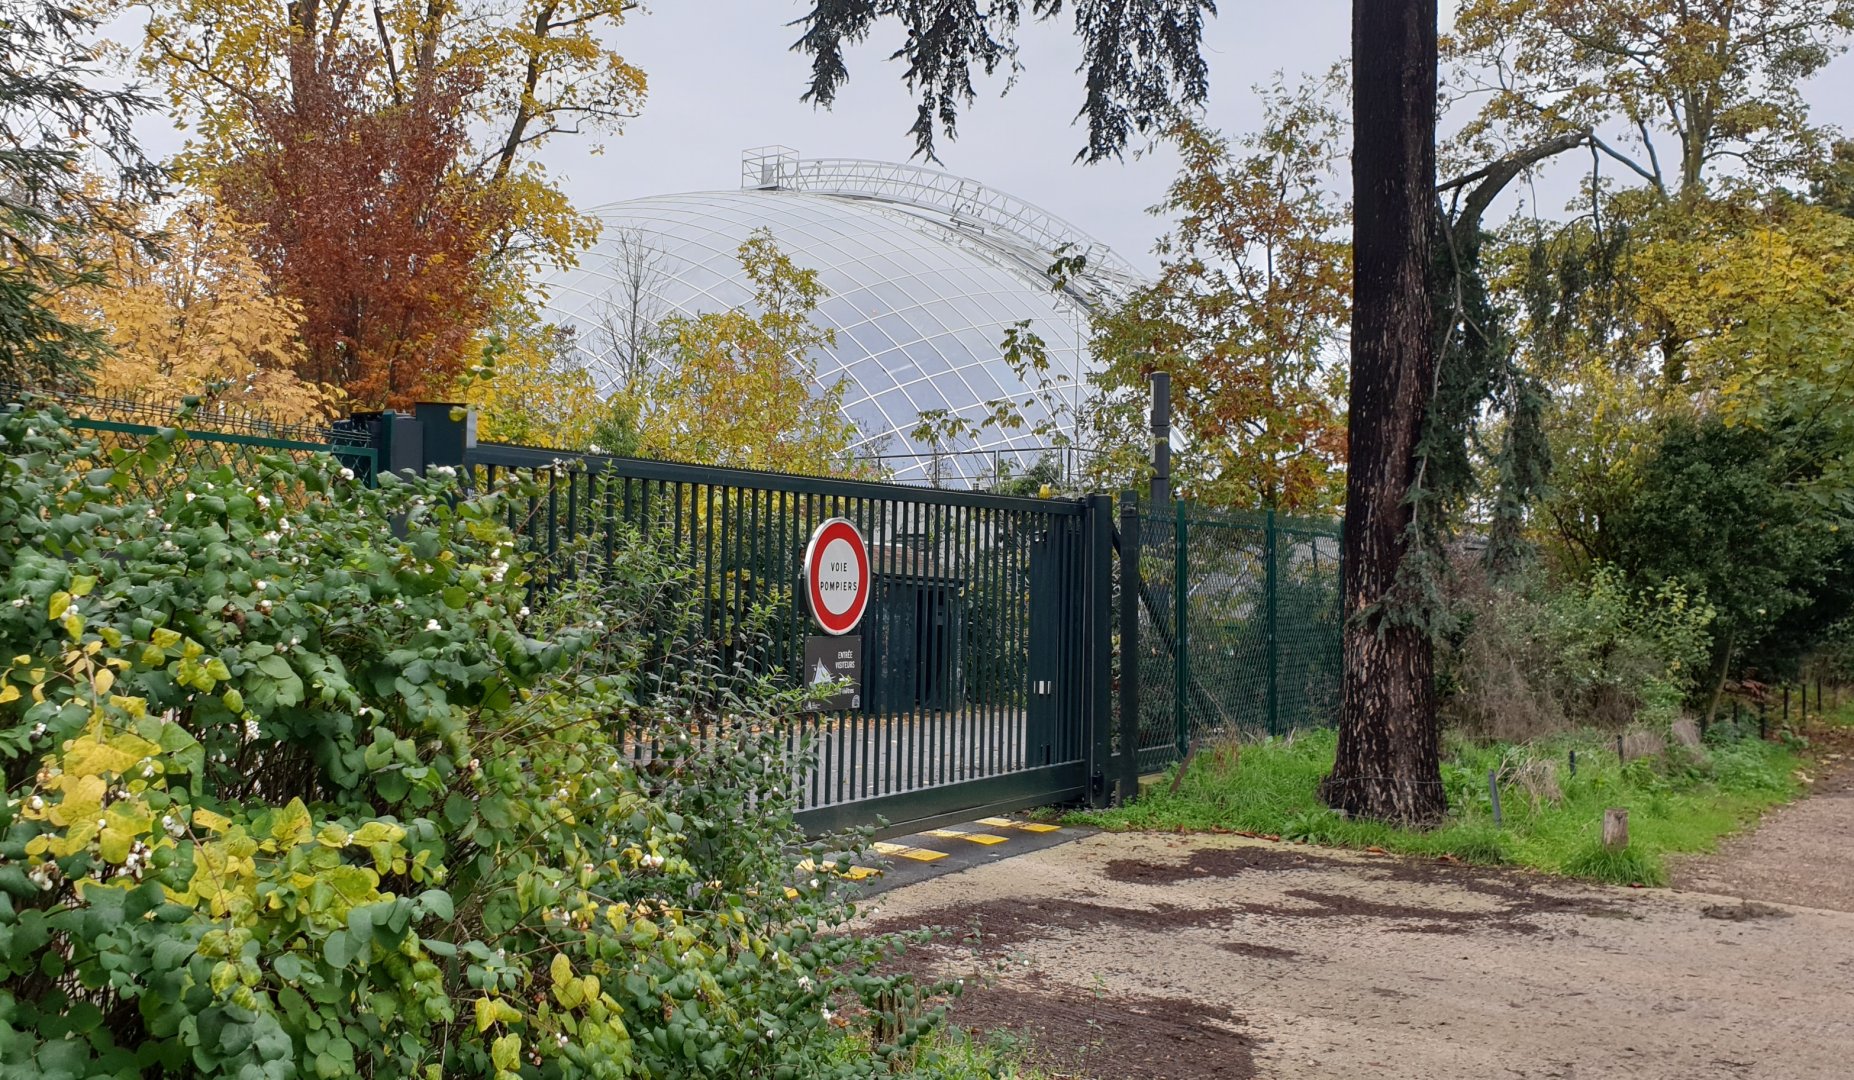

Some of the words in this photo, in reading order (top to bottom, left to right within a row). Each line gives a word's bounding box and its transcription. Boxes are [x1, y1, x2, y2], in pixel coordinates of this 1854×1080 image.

[831, 562, 847, 572] VOIE
[820, 581, 857, 591] POMPIERS
[838, 650, 853, 659] ENTRÉE
[835, 661, 855, 669] VISITEURS
